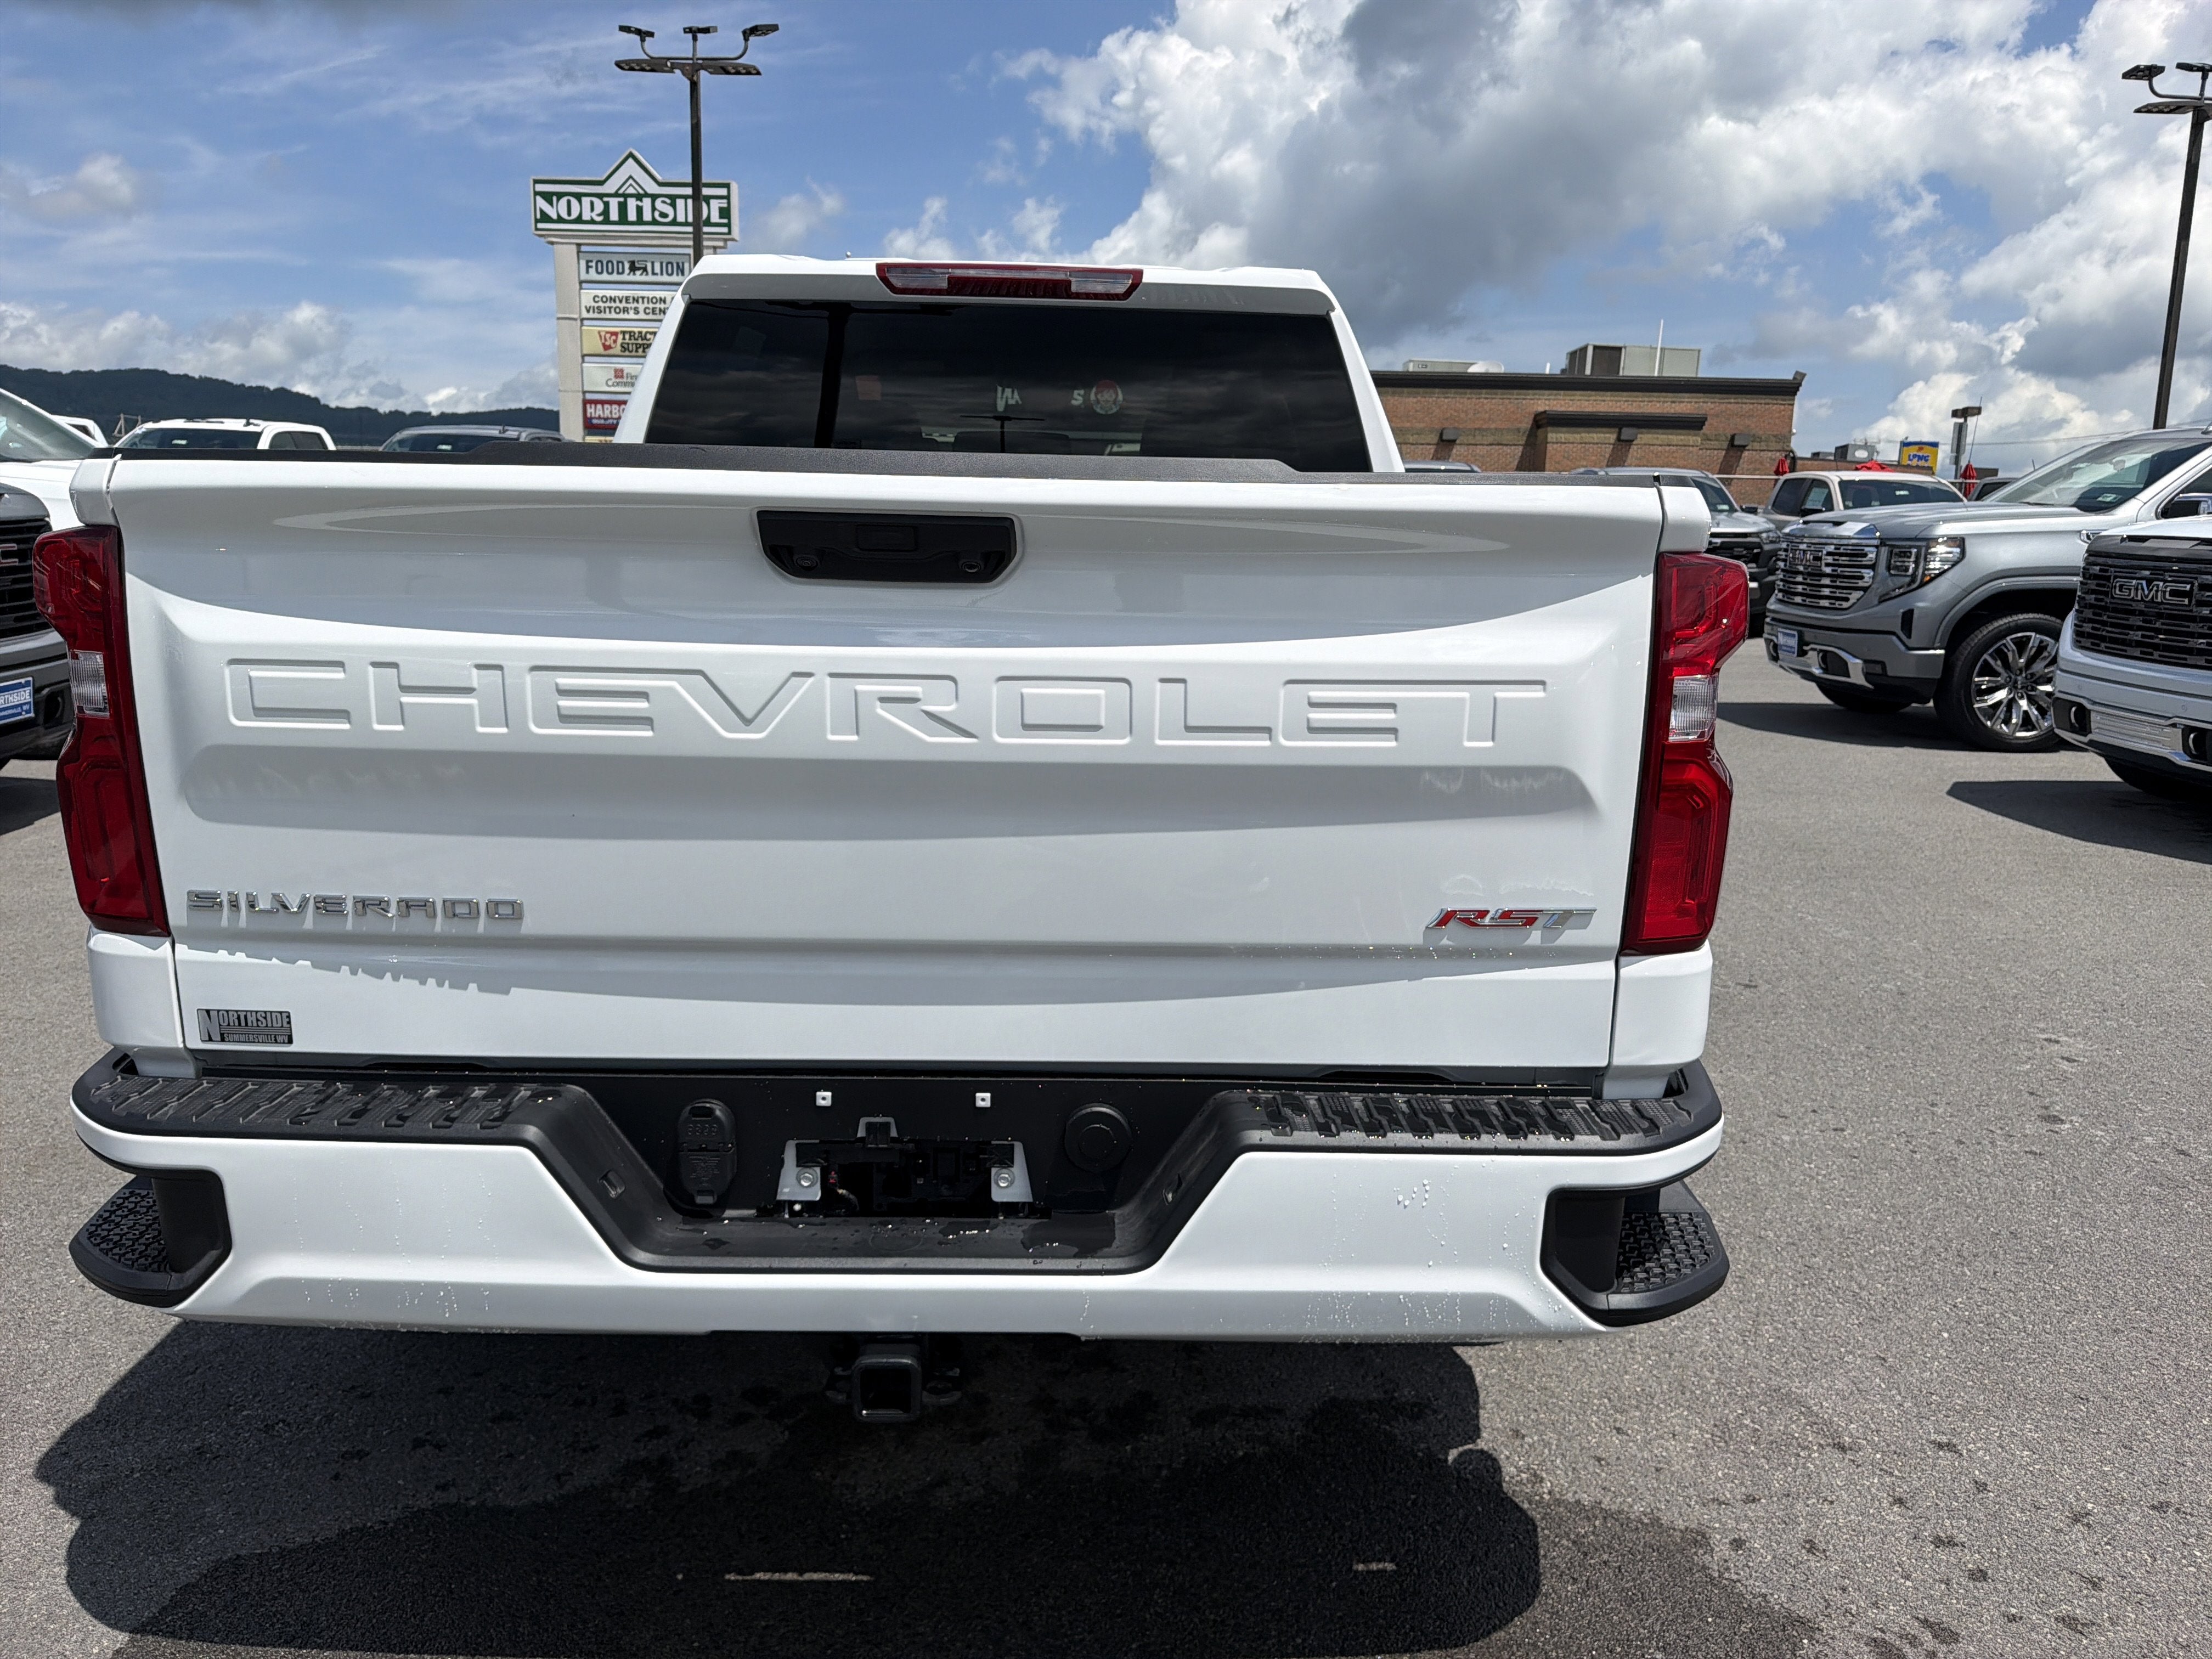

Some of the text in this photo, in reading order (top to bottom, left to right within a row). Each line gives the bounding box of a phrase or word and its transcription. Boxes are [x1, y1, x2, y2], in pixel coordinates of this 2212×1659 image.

[535, 195, 728, 223] NORTHSIDE
[585, 259, 685, 276] FOOD LION
[584, 305, 669, 316] VISITOR'S CEN
[592, 295, 667, 305] CONVENTION
[620, 342, 652, 353] SUPP
[2112, 578, 2191, 605] GMC
[225, 658, 1547, 749] CHEVROLET
[186, 889, 524, 920] SILVERADO
[1425, 906, 1597, 929] RST
[198, 1009, 291, 1041] NORTHSIDE
[224, 1033, 289, 1043] SUMMERSVILLE WV
